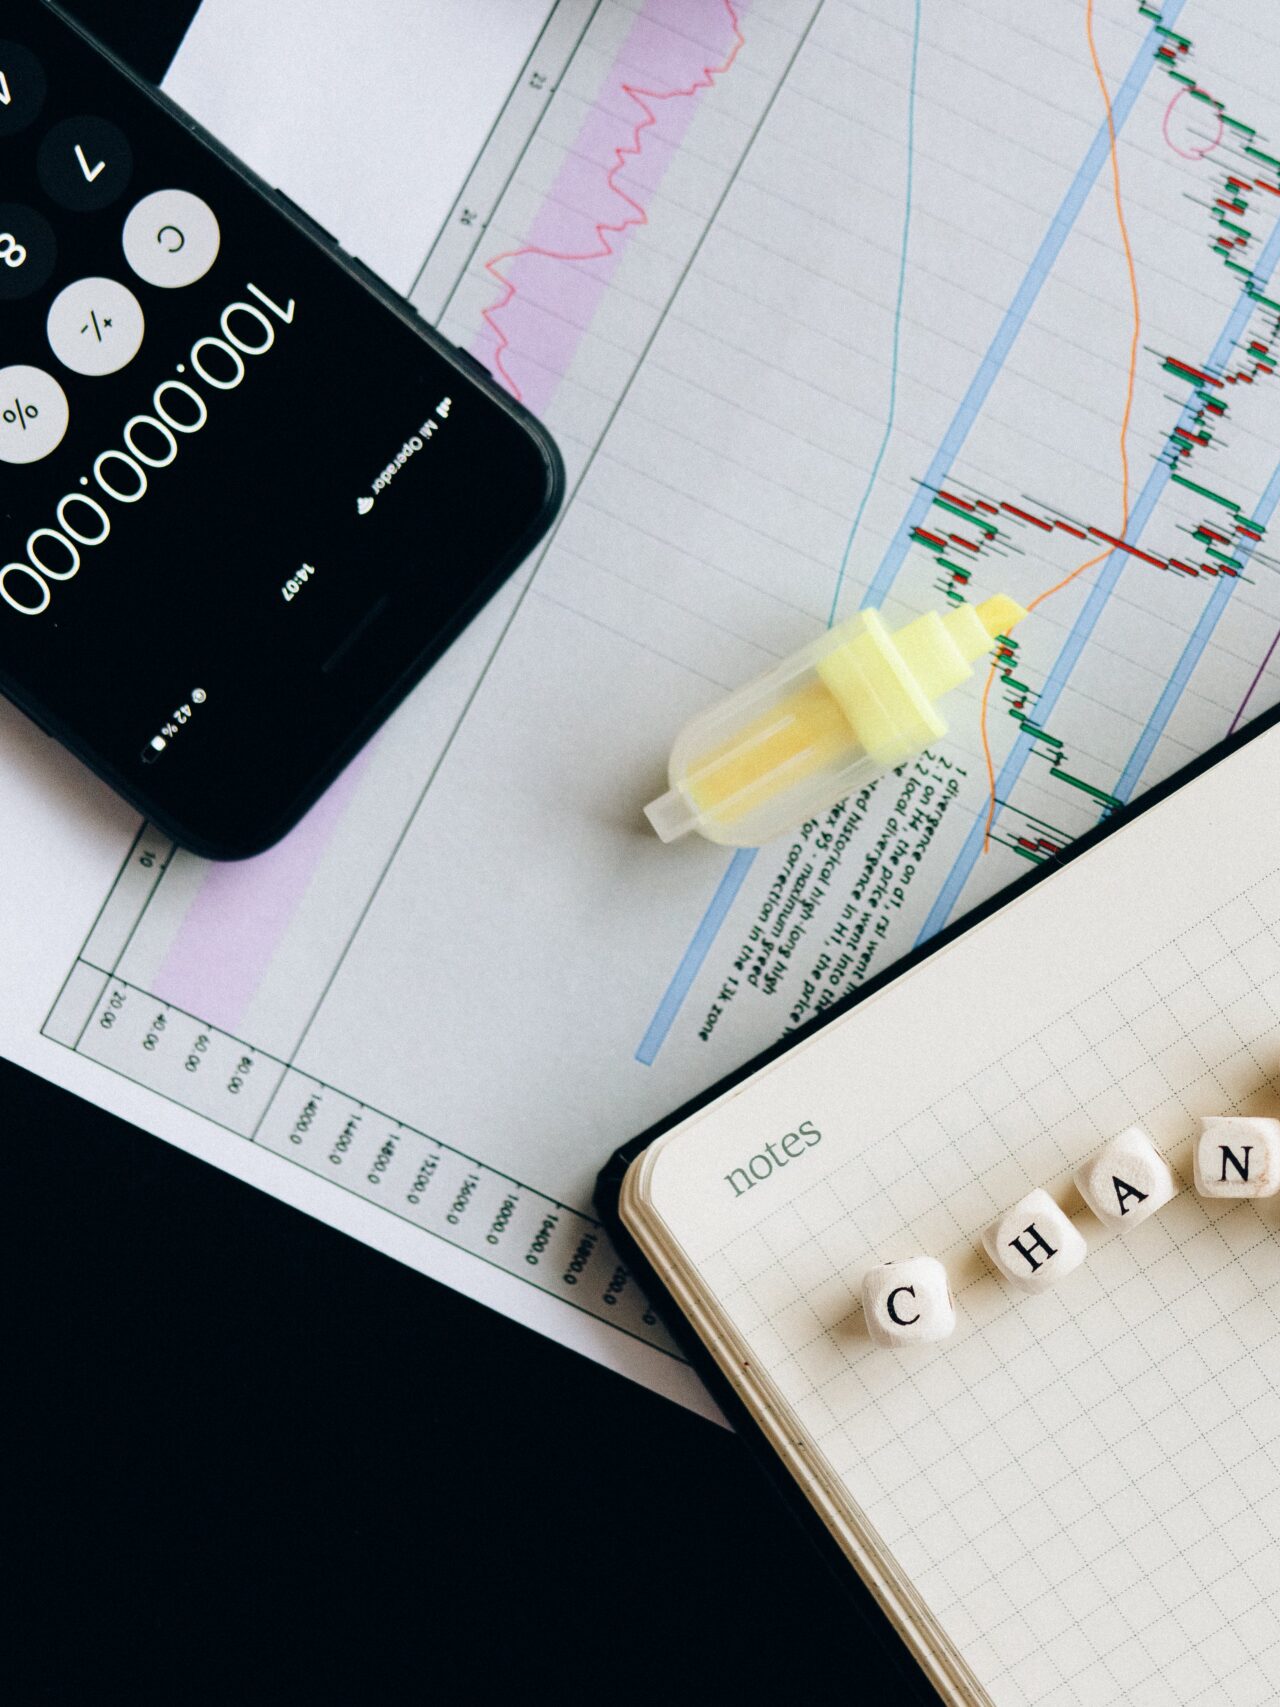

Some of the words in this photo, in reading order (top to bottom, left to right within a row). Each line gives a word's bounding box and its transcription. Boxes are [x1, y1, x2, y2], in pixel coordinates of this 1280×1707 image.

[75, 145, 105, 182] 7
[158, 226, 184, 252] C
[3, 399, 38, 429] %
[418, 418, 439, 439] Mi
[0, 283, 295, 615] 100.000.000
[368, 432, 425, 498] Operador
[278, 560, 316, 602] 14:07
[160, 720, 179, 739] %
[172, 701, 195, 725] 42
[893, 776, 921, 816] local
[918, 784, 935, 806] on
[798, 816, 820, 843] for
[907, 776, 962, 863] divergence
[138, 849, 156, 868] 10
[814, 830, 833, 852] 95
[817, 811, 863, 886] historical
[847, 815, 901, 901] divergence
[888, 838, 910, 867] the
[756, 842, 807, 925] correction
[864, 866, 896, 910] price
[899, 863, 916, 885] on
[769, 862, 816, 939] maximum
[841, 902, 858, 921] in
[748, 924, 765, 943] in
[845, 909, 874, 951] went
[872, 914, 893, 939] rsi
[732, 944, 755, 973] the
[742, 938, 778, 988] greed
[758, 959, 788, 997] high
[810, 952, 832, 981] the
[827, 952, 854, 987] into
[851, 938, 880, 980] went
[717, 975, 740, 1003] 13k
[786, 980, 819, 1025] price
[99, 991, 126, 1030] 20.00
[696, 1003, 723, 1042] zone
[142, 1013, 169, 1051] 40.00
[183, 1034, 211, 1073] 60.00
[227, 1056, 254, 1095] 80.00
[288, 1092, 324, 1146] 14000.0
[327, 1112, 362, 1166] 14400.0
[366, 1132, 401, 1186] 14800.0
[724, 1120, 822, 1198] notes
[405, 1152, 441, 1206] 15200.0
[444, 1172, 481, 1226] 15600.0
[484, 1192, 520, 1246] 16000.0
[886, 1285, 920, 1327] C
[1009, 1223, 1057, 1272] H
[1112, 1176, 1149, 1215] A
[1219, 1146, 1253, 1182] N
[524, 1212, 559, 1266] 16400.0
